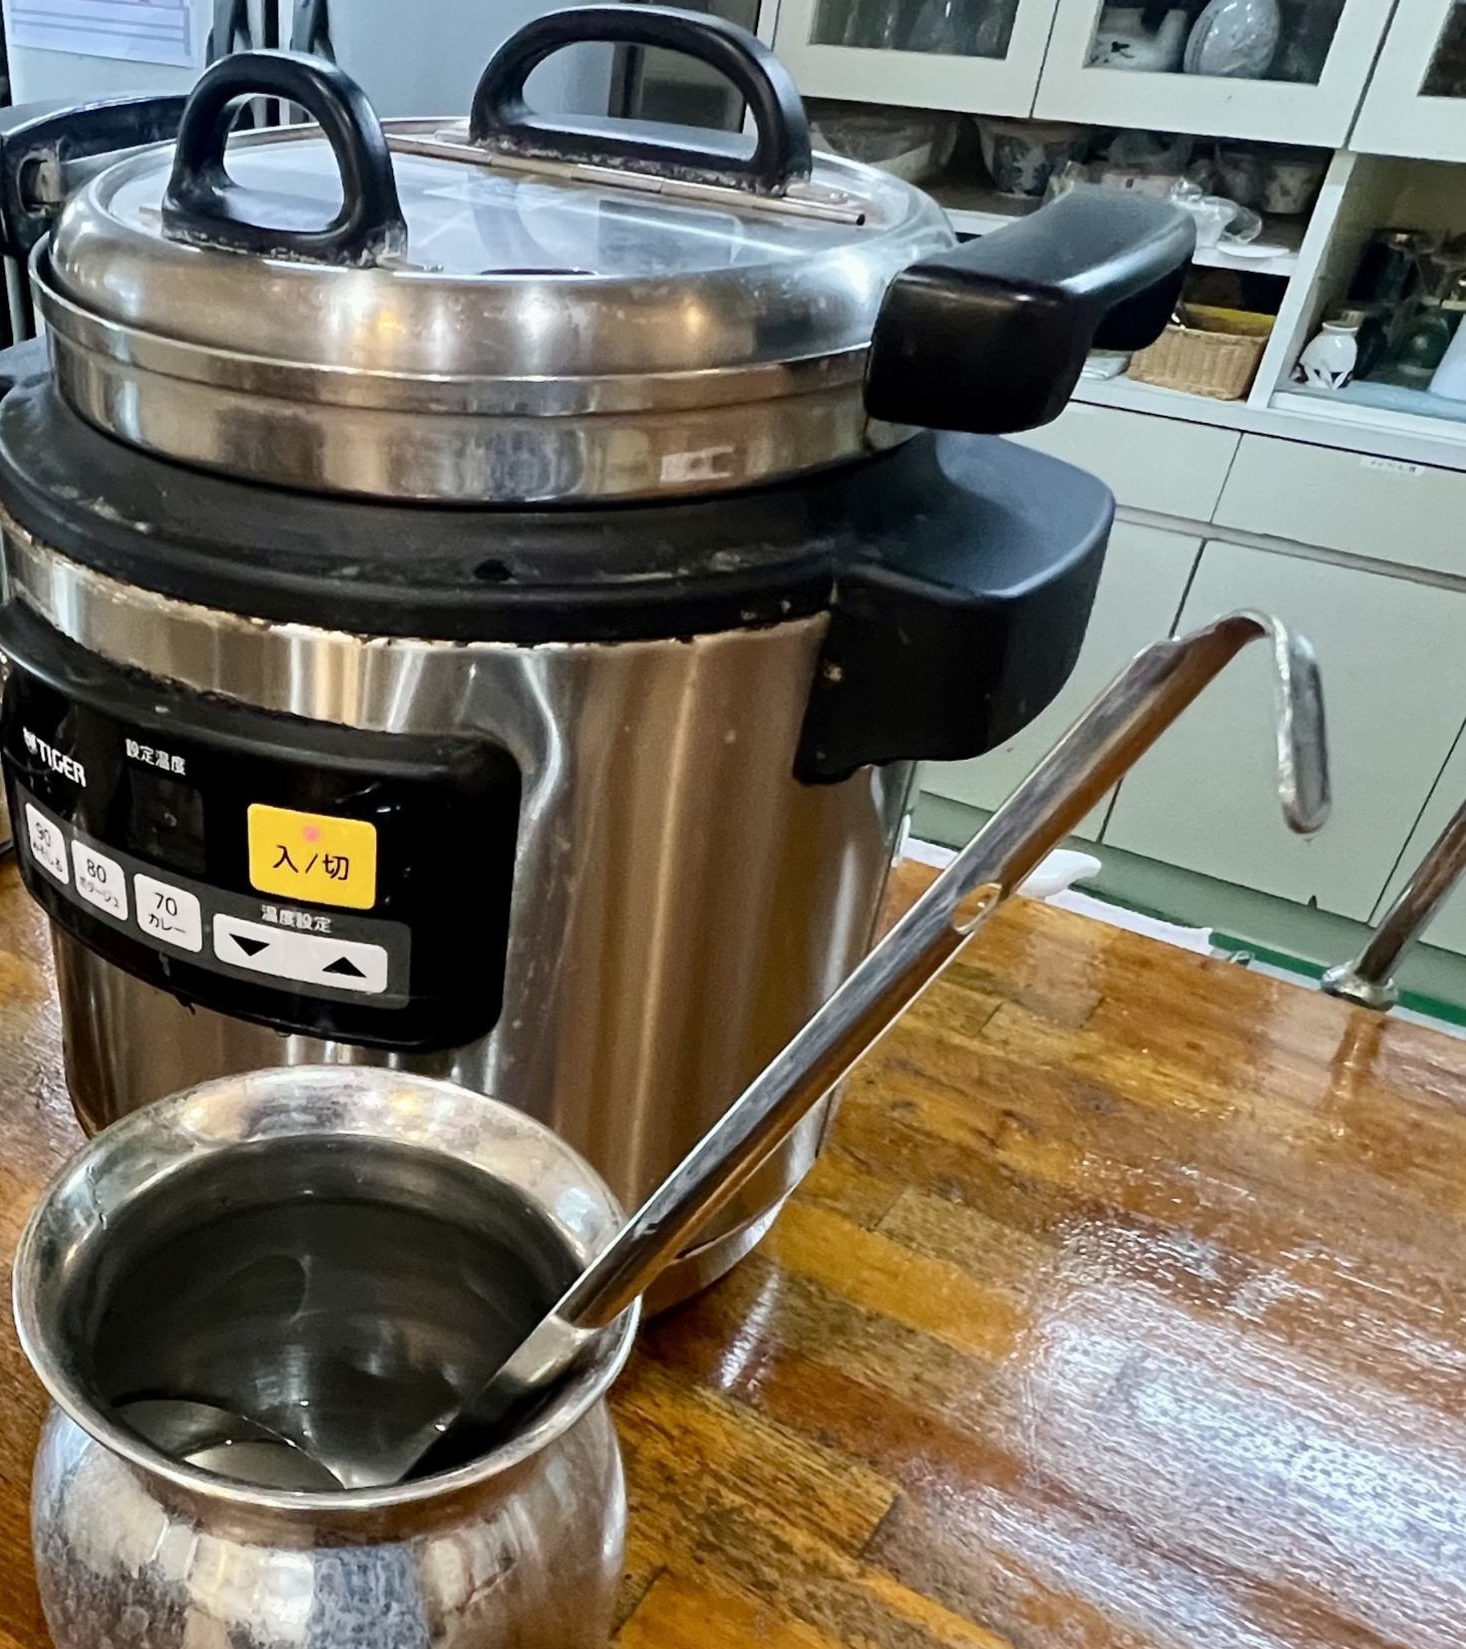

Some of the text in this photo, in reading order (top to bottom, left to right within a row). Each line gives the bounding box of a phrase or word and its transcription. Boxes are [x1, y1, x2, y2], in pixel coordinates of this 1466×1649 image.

[36, 737, 86, 787] TIGER
[125, 738, 186, 775] 設定温度
[35, 822, 51, 848] 90
[86, 858, 107, 884] 80
[154, 892, 177, 917] 70
[147, 913, 186, 934] カレー
[261, 904, 332, 933] 温度設定
